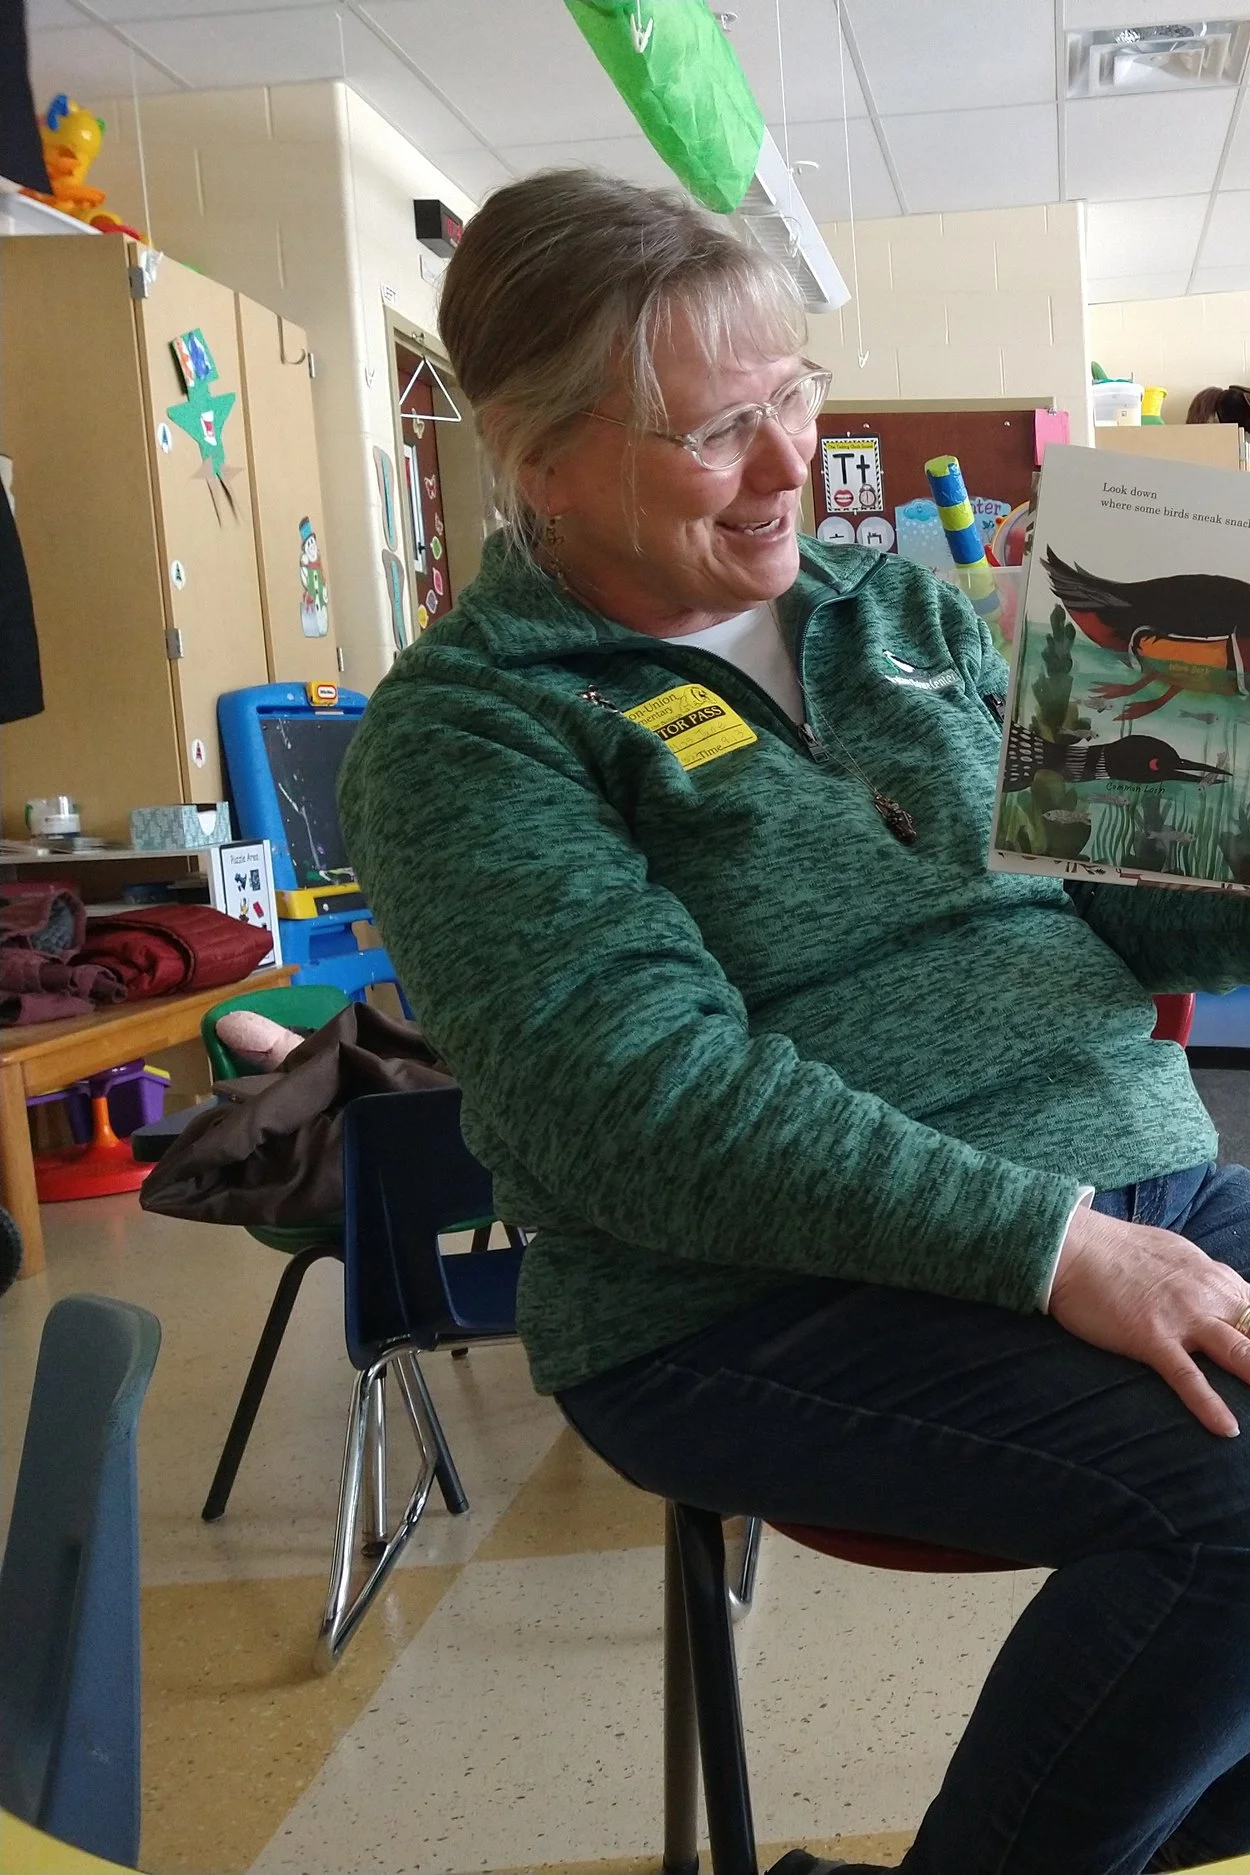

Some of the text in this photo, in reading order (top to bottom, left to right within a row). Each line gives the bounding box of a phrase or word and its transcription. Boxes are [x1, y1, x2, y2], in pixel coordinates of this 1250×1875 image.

[1102, 482, 1157, 499] Look down
[1101, 499, 1131, 511] where
[1134, 504, 1160, 515] some
[1164, 507, 1190, 519] birds
[1192, 513, 1222, 524] sneak
[657, 719, 689, 740] TOR
[688, 706, 722, 725] PASS
[698, 744, 722, 760] Time
[1106, 782, 1141, 792] Common
